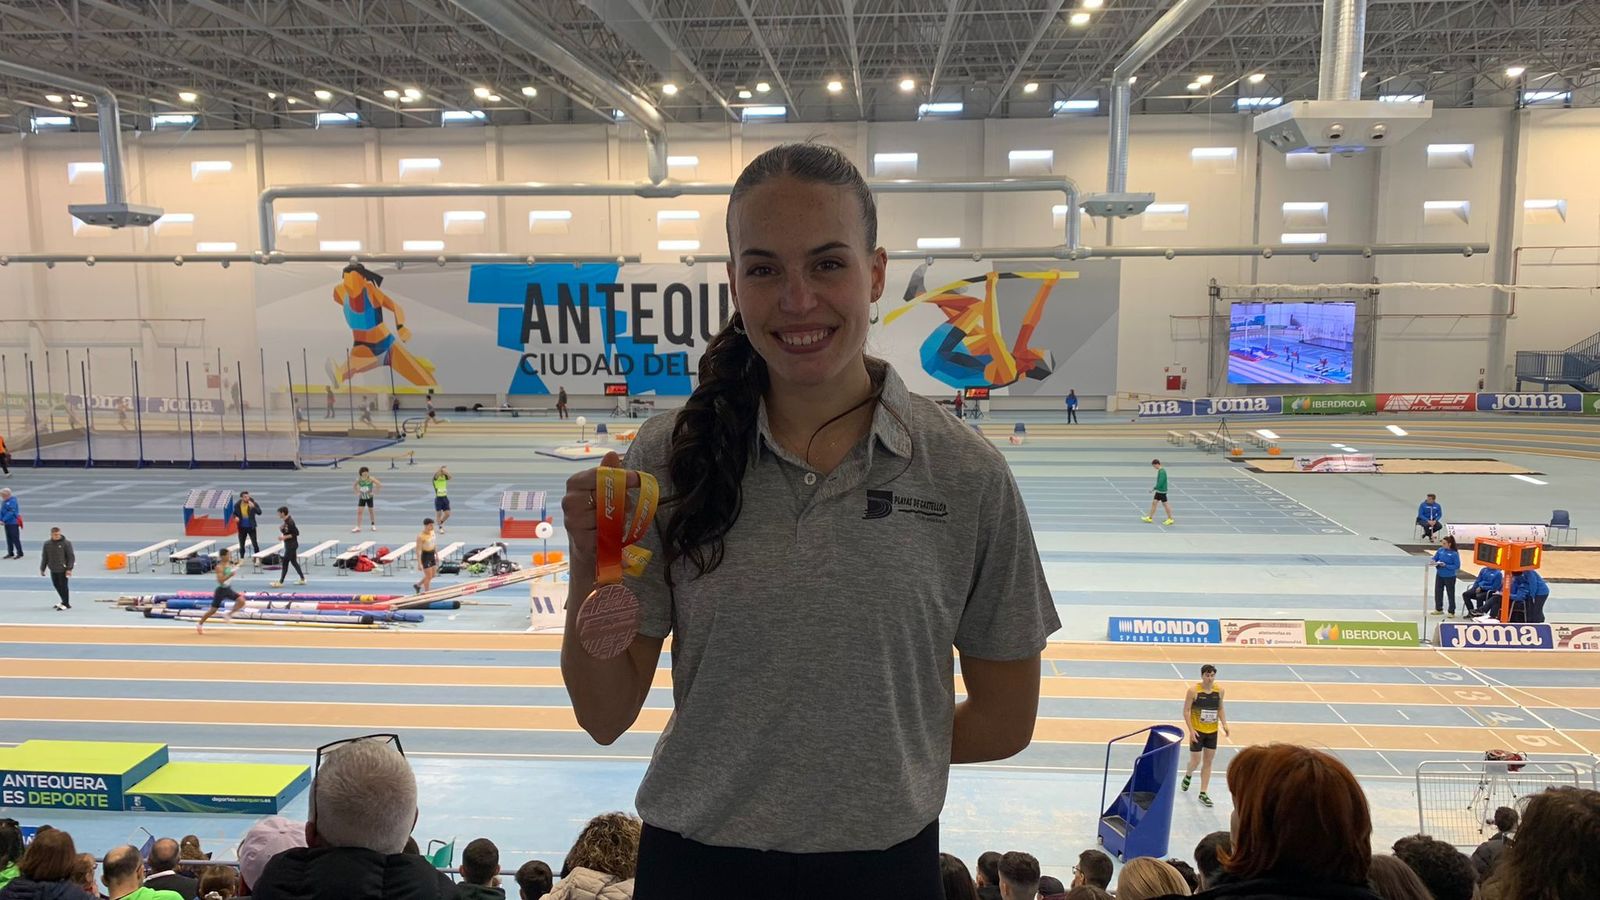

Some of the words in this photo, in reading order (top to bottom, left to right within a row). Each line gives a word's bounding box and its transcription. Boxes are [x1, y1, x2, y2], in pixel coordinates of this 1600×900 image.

[520, 282, 729, 347] ANTEQU
[520, 353, 634, 376] CIUDAD
[643, 353, 698, 376] DEL
[1312, 399, 1367, 409] IBERDROLA
[1413, 394, 1471, 406] RFEA
[894, 495, 912, 506] PLAYAS
[913, 499, 919, 508] DE
[1133, 619, 1209, 636] MONDO
[1119, 634, 1150, 642] SPORT
[1341, 629, 1412, 641] IBERDROLA
[1453, 690, 1493, 702] 3
[1485, 711, 1525, 724] 4
[1515, 734, 1563, 748] 5
[2, 773, 108, 791] ANTEQUERA
[2, 790, 26, 805] ES
[28, 791, 109, 808] DEPORTE
